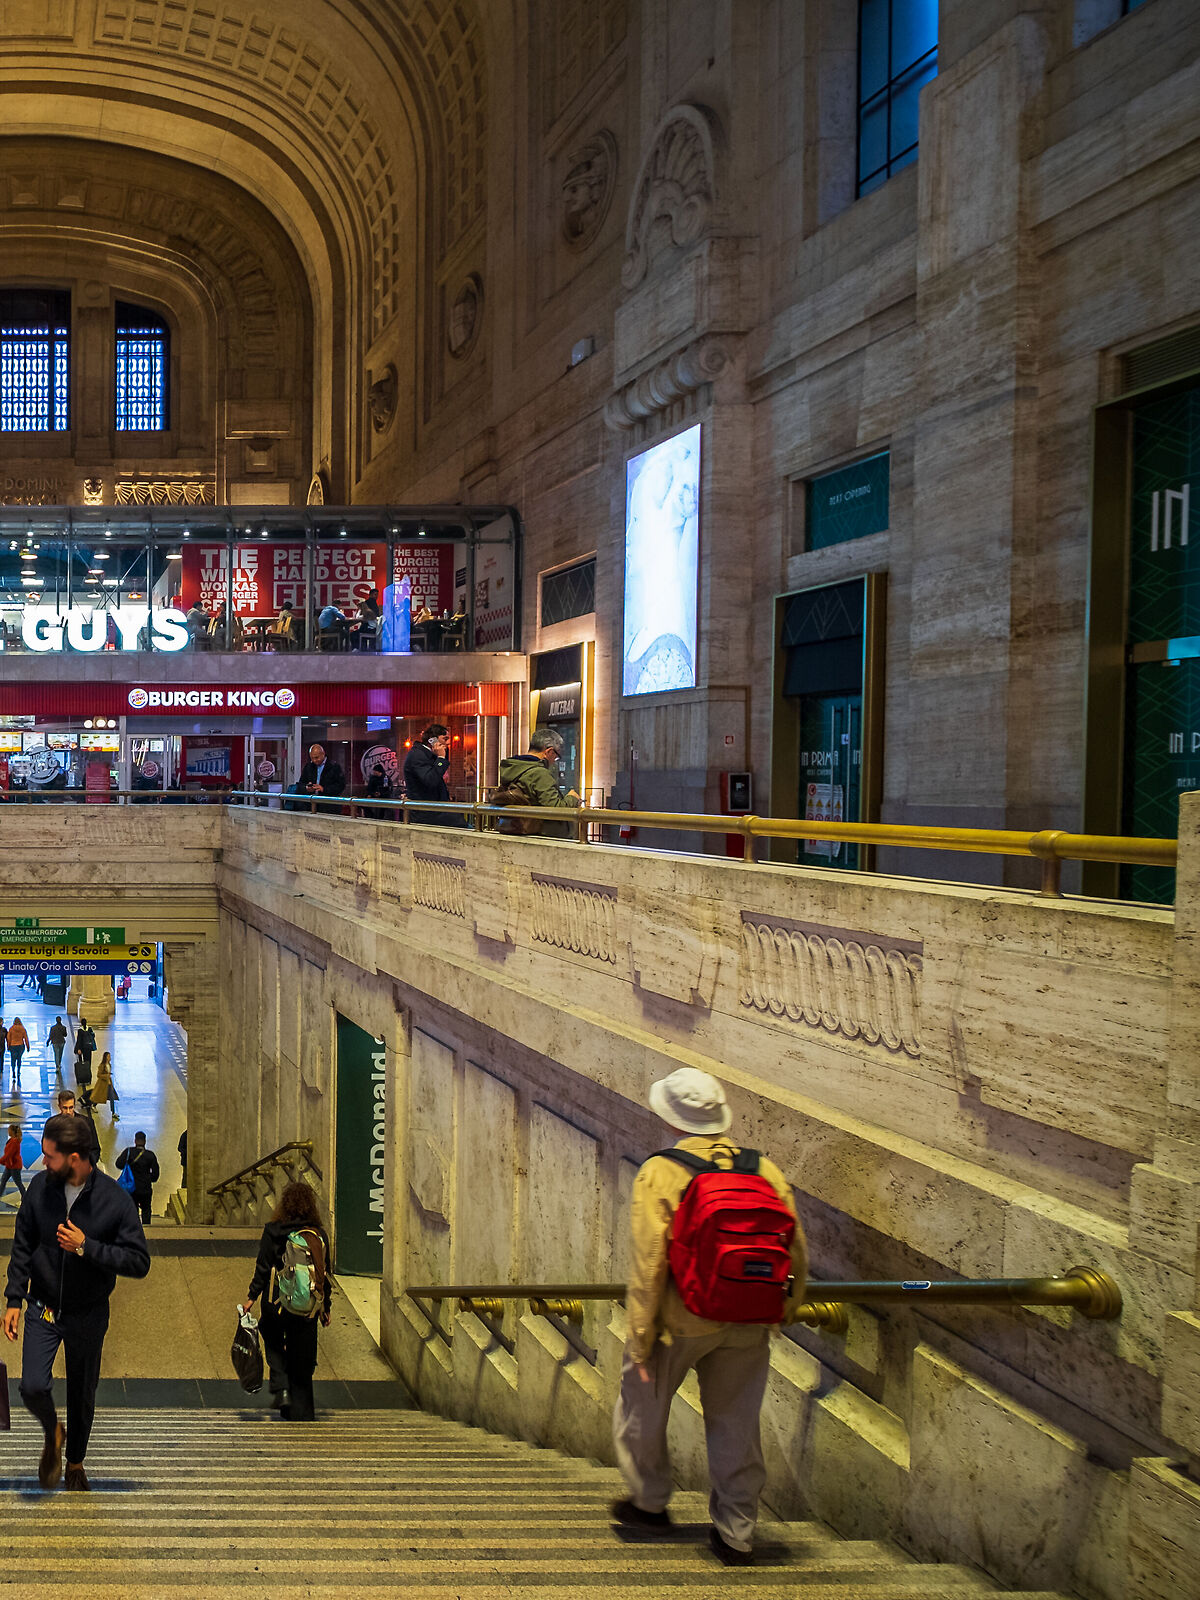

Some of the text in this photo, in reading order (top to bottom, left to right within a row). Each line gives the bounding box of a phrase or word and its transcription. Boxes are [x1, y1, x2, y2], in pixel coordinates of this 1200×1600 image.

[201, 549, 259, 569] THE
[273, 549, 376, 565] PERFECT
[414, 549, 439, 557] BEST
[335, 566, 376, 580] CUT
[407, 586, 439, 594] YOUR
[22, 608, 189, 652] GUYS
[148, 691, 275, 706] BURGER KING
[365, 752, 397, 767] BURGER
[30, 946, 55, 957] Luigi
[59, 946, 69, 955] di
[72, 946, 109, 955] Savoia
[63, 961, 72, 970] al
[74, 961, 97, 970] Serio
